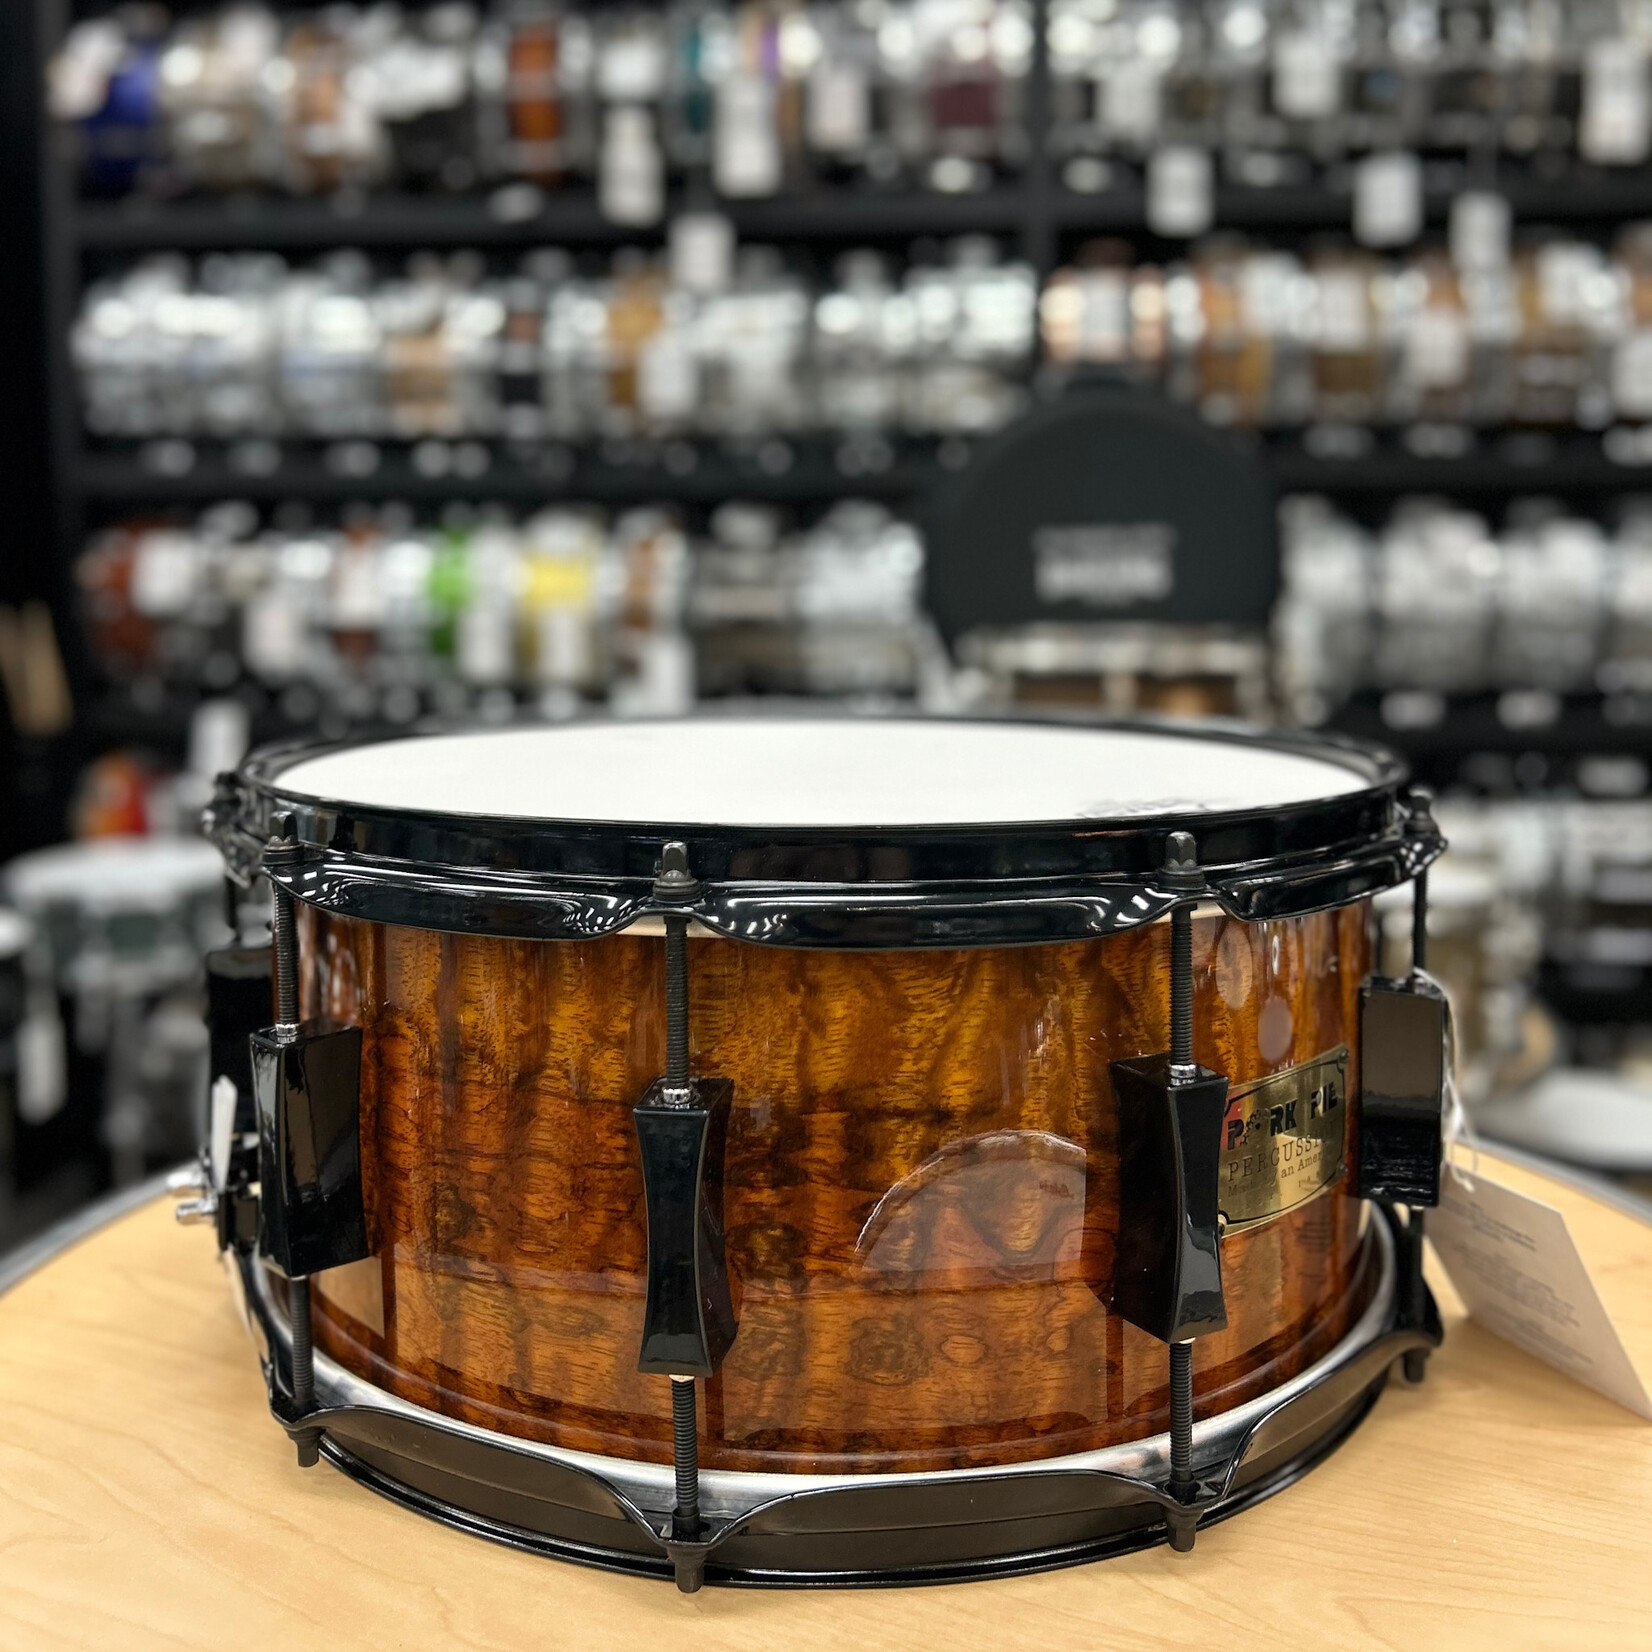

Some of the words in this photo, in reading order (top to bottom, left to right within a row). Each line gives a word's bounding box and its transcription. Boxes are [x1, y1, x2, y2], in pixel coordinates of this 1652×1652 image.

[1311, 1082, 1338, 1120] PIE
[1228, 1122, 1333, 1182] PERCUSSI
[1281, 1165, 1295, 1179] an
